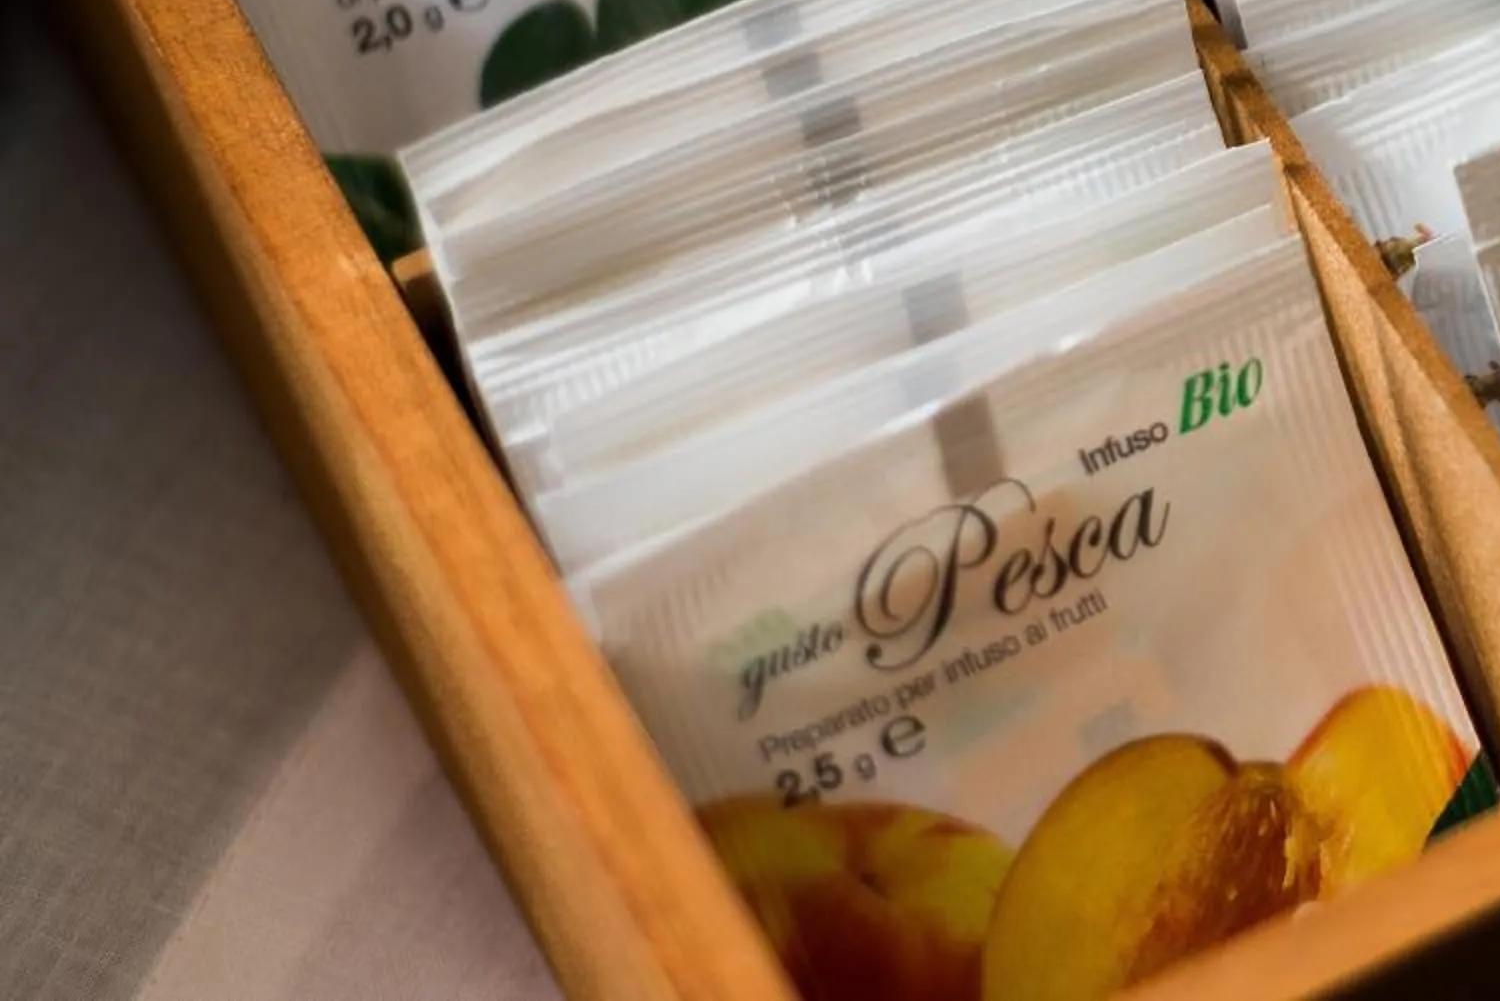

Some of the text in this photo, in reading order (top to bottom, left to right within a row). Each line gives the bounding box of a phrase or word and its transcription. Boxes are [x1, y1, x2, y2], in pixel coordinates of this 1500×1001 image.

[352, 4, 413, 55] 2,0
[1079, 357, 1263, 476] Infuso Bio
[737, 477, 1170, 723] gusto Pesca
[757, 587, 1109, 763] Preparato per infuso ai frutti
[776, 751, 843, 810] 2,5
[855, 753, 876, 781] g
